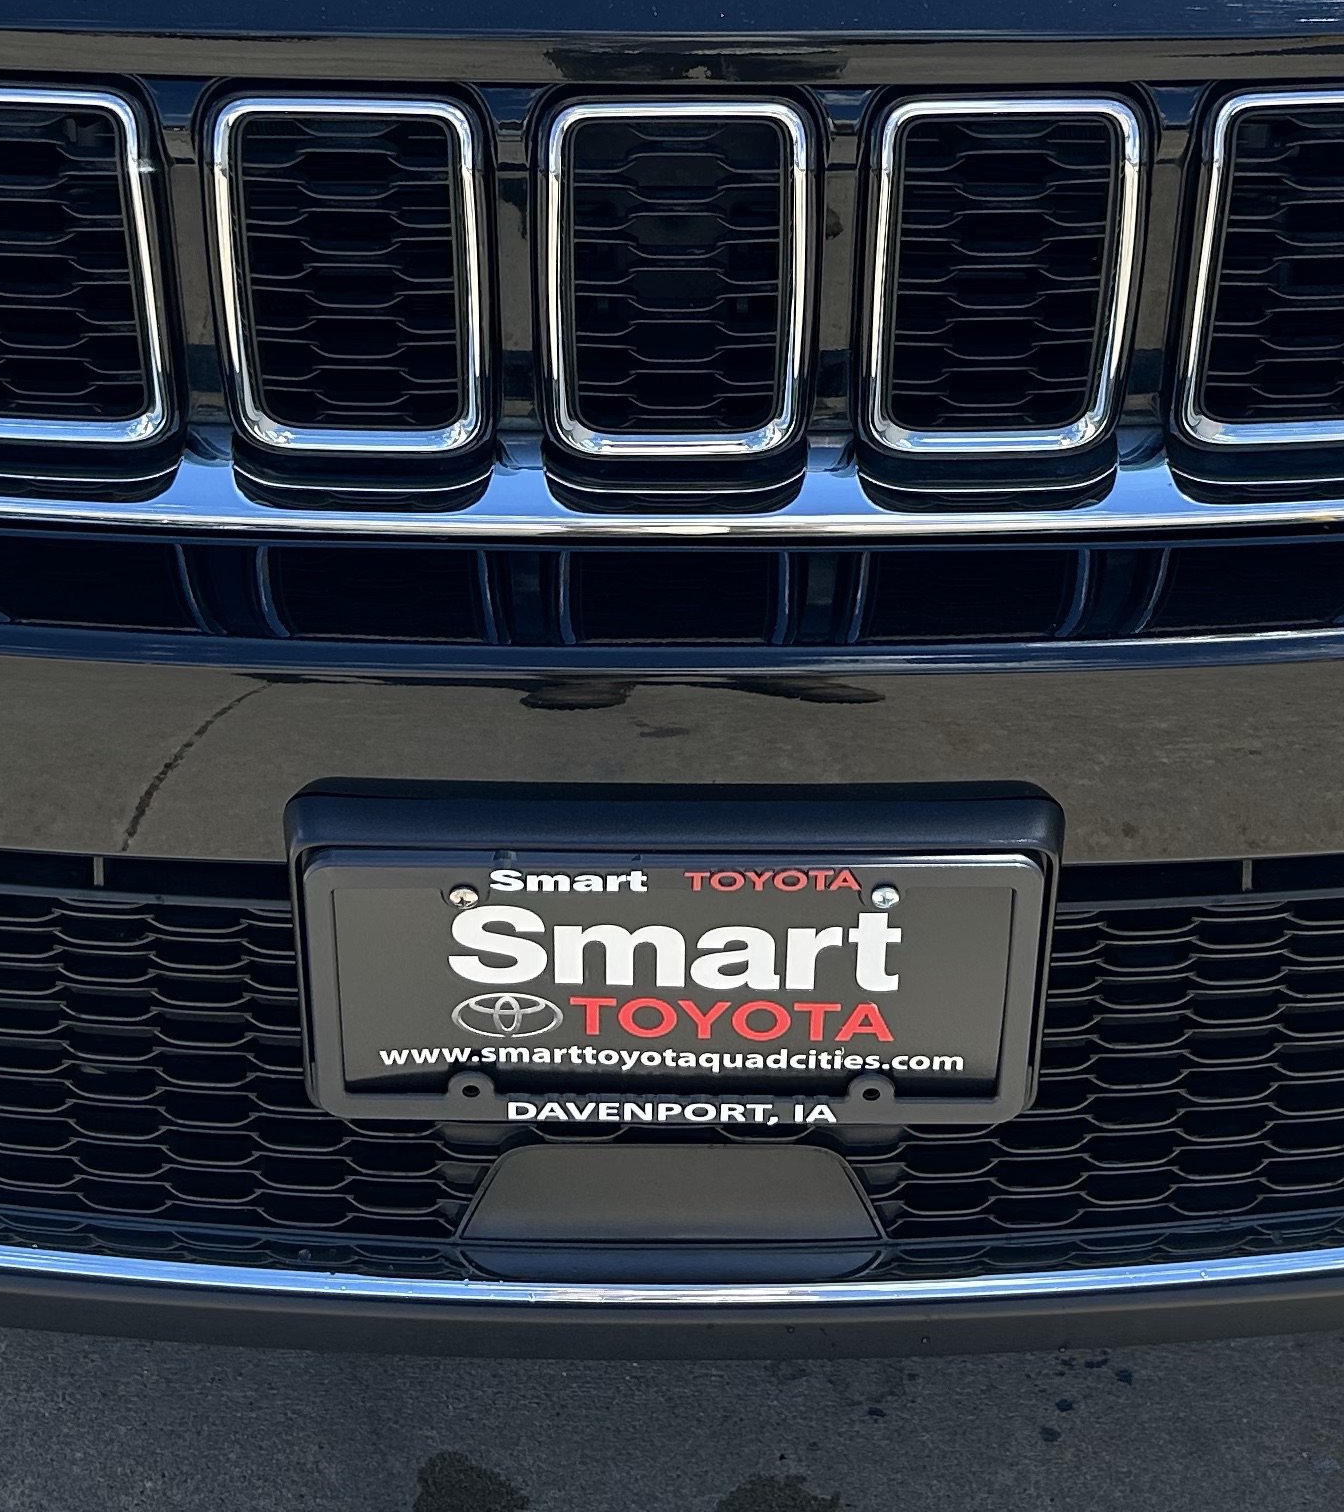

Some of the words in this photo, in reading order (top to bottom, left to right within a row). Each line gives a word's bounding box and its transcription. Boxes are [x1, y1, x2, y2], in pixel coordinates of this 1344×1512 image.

[489, 868, 649, 893] Smart
[684, 869, 862, 893] TOYOTA
[448, 905, 902, 992] Smart
[569, 996, 895, 1042] TOYOTA
[379, 1043, 965, 1073] www.smarttoyotaquadcities.com
[507, 1101, 779, 1126] DAVENPORT,
[793, 1102, 838, 1124] IA
